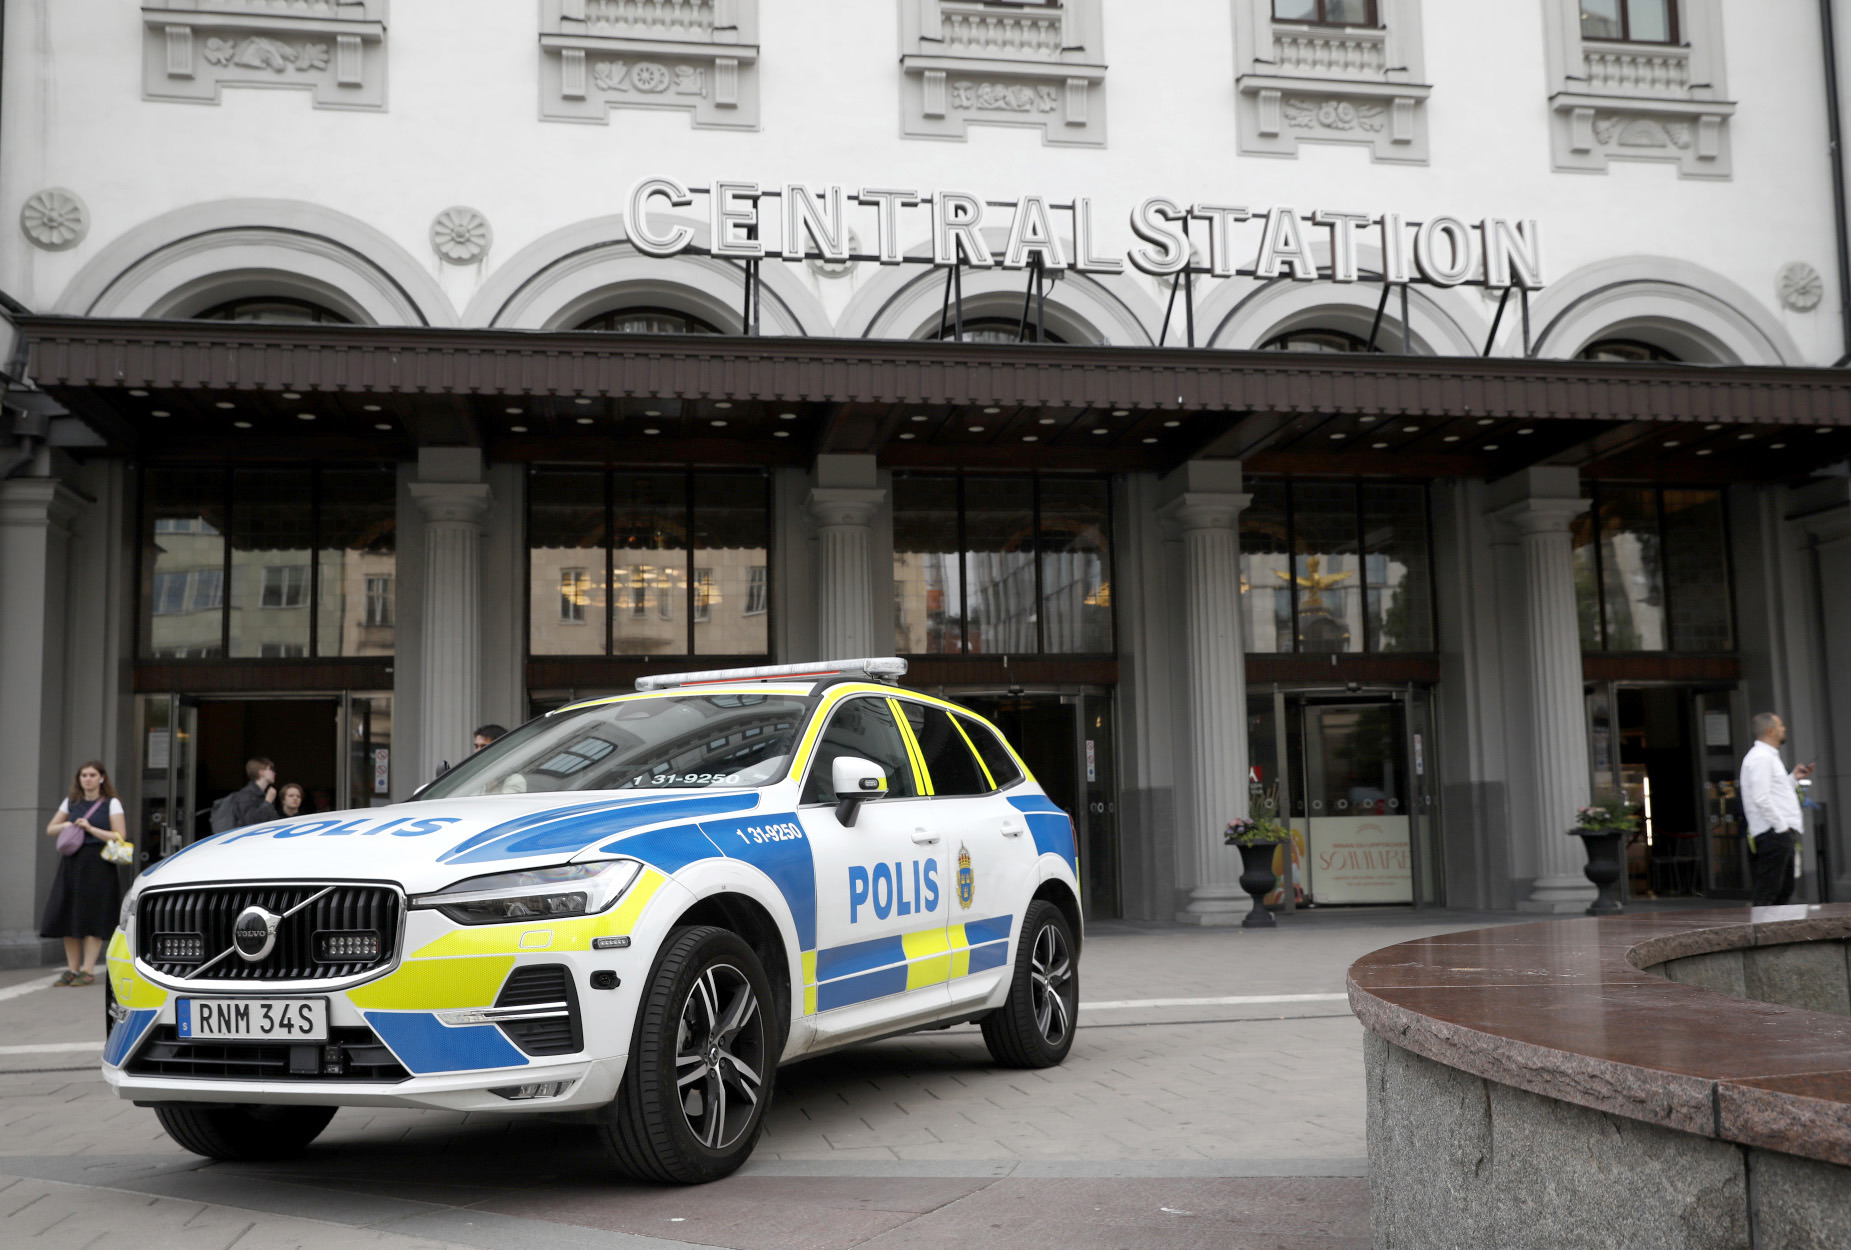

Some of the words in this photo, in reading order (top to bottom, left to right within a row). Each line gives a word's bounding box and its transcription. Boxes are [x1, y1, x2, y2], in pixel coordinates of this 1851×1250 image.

[622, 174, 1545, 290] CENTRALSTATION
[633, 776, 643, 786] 1
[651, 773, 740, 785] 31-9250
[218, 817, 463, 845] POLIS
[736, 828, 751, 845] 1
[748, 822, 803, 844] 31-9250
[848, 858, 939, 924] POLIS
[236, 929, 267, 938] VOLVO
[182, 1022, 189, 1031] S
[199, 1003, 250, 1034] RNM
[260, 1003, 314, 1034] 34S
